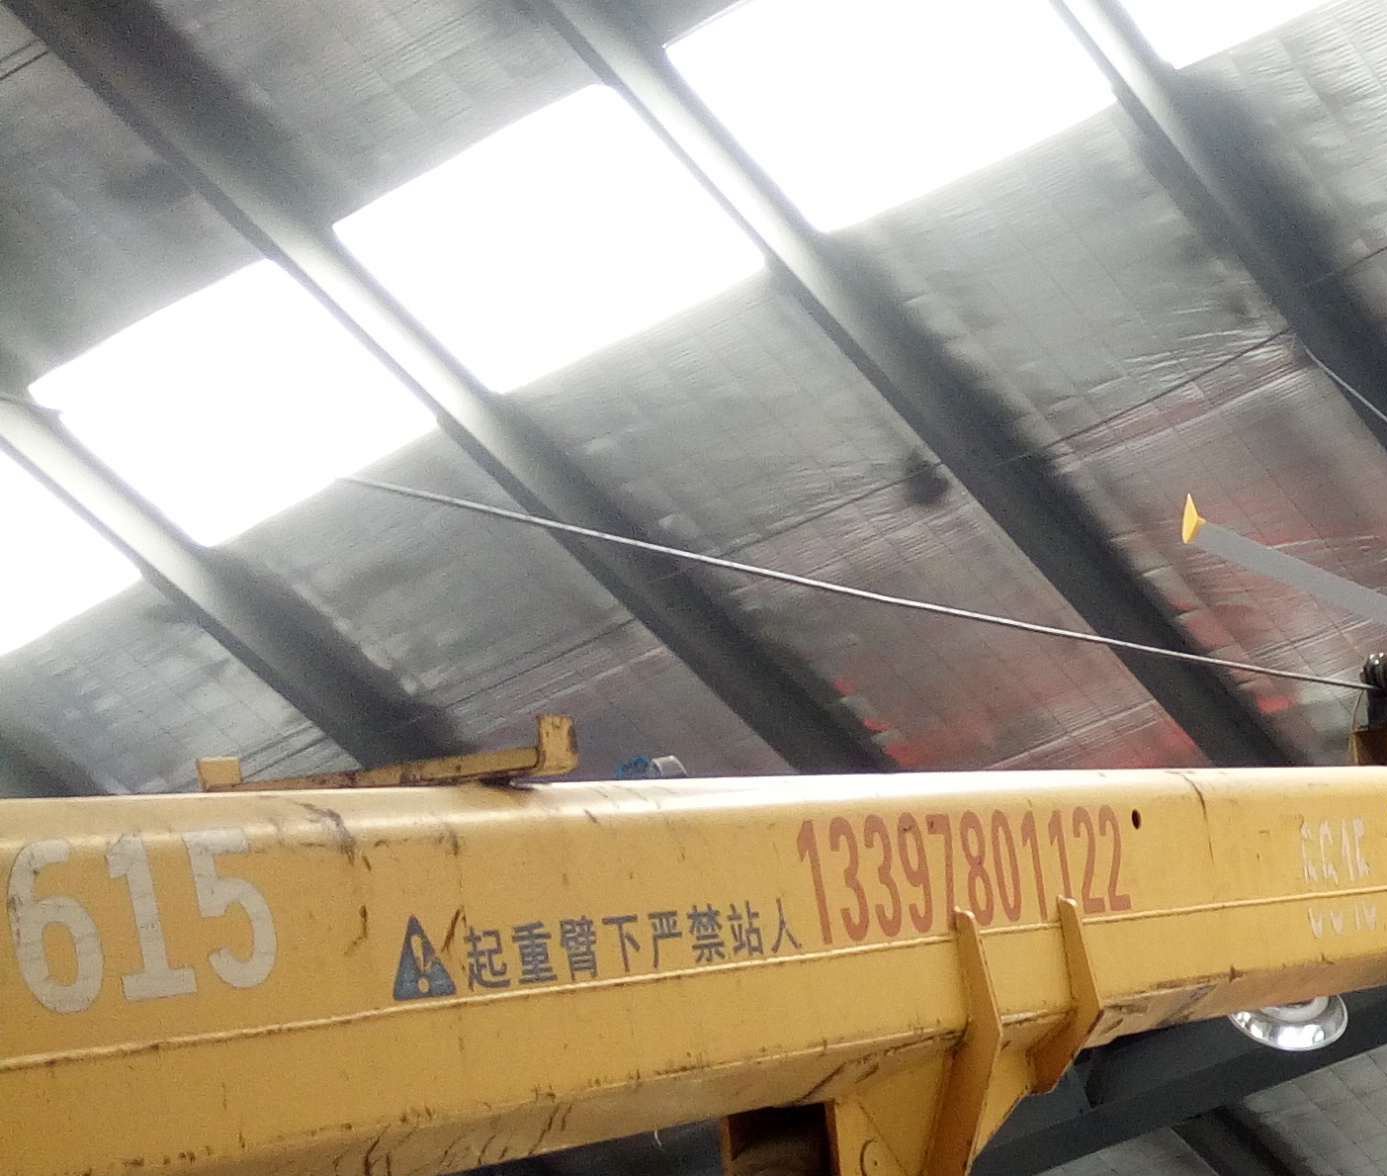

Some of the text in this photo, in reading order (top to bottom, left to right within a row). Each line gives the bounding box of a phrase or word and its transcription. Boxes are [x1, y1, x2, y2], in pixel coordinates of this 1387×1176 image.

[6, 828, 278, 1014] 615
[466, 898, 802, 990] 起重臂下严禁站人
[798, 805, 1131, 944] 13397801122
